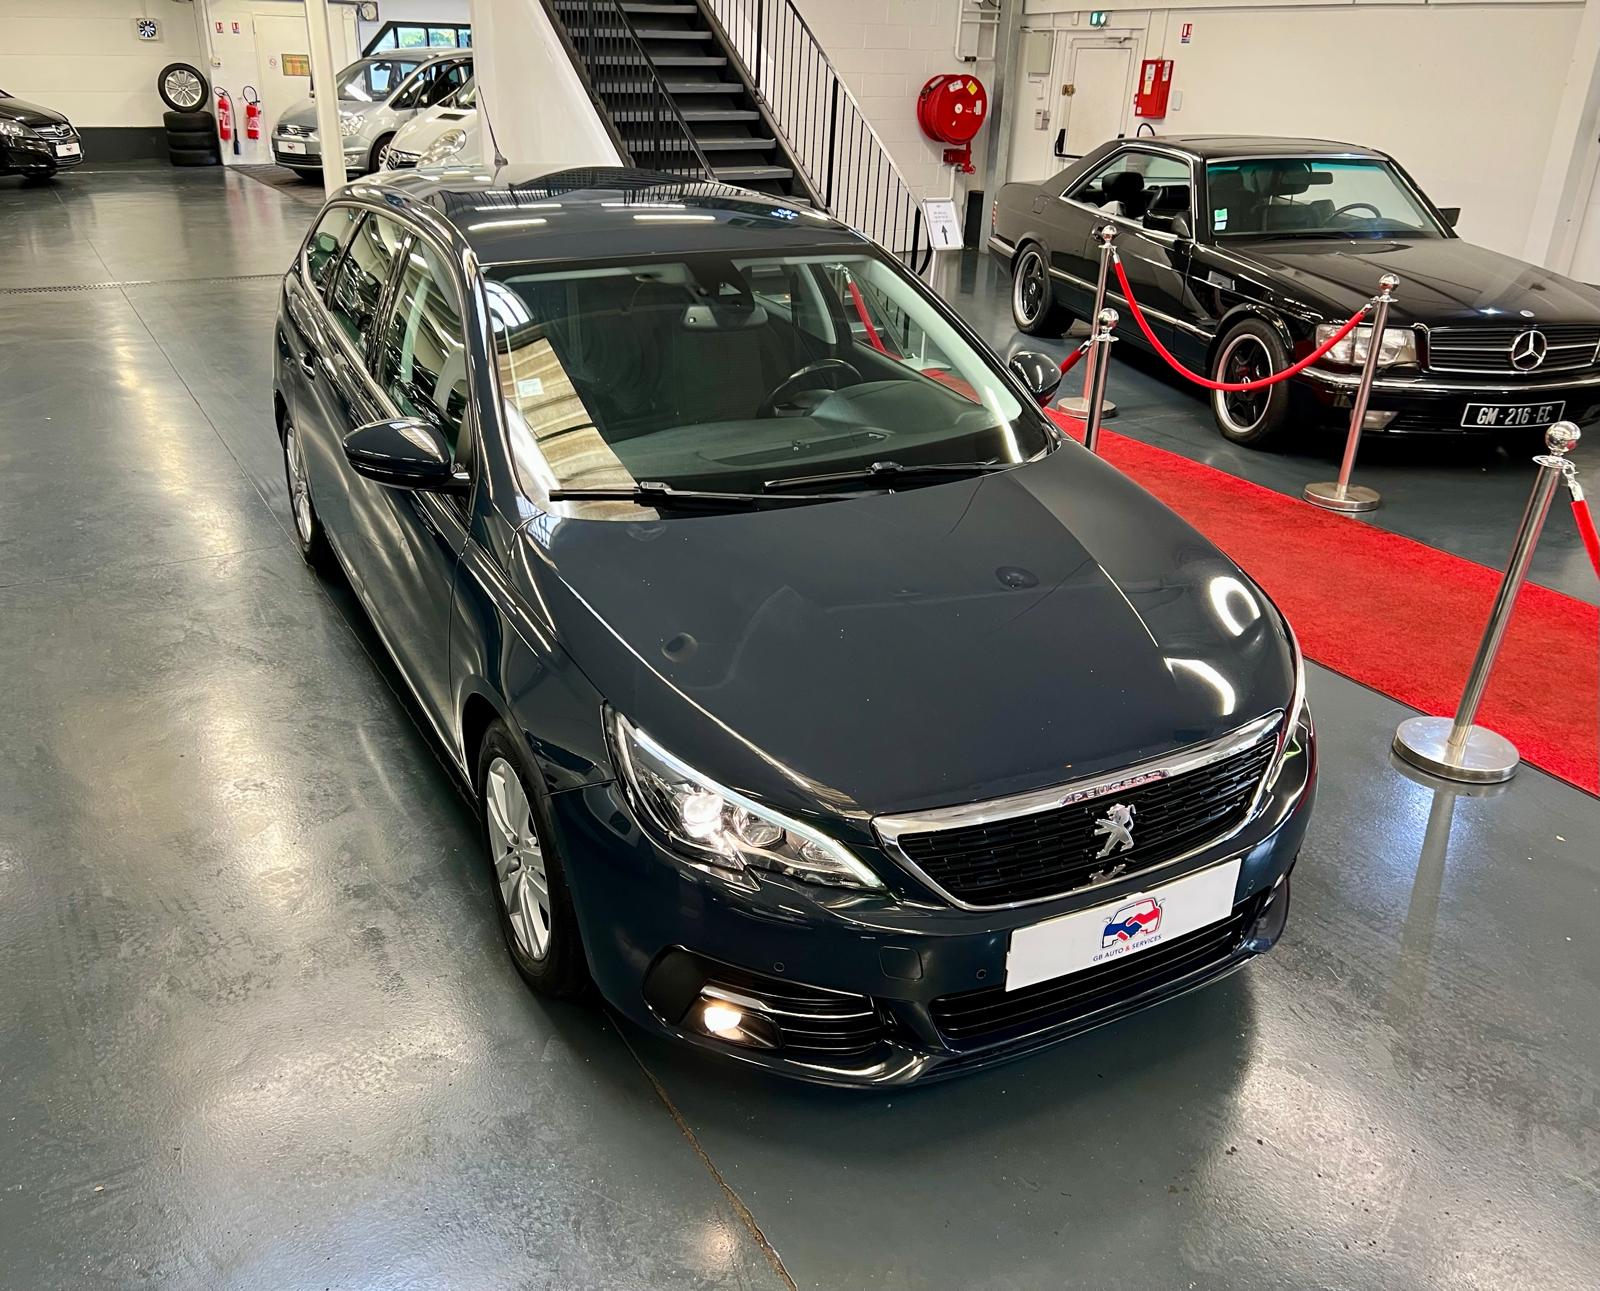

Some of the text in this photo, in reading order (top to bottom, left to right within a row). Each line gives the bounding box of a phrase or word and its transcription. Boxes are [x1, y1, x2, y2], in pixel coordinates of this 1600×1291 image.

[1074, 770, 1162, 800] PEUGEOT
[1104, 947, 1124, 958] AUTO
[1132, 934, 1162, 949] SERVICES
